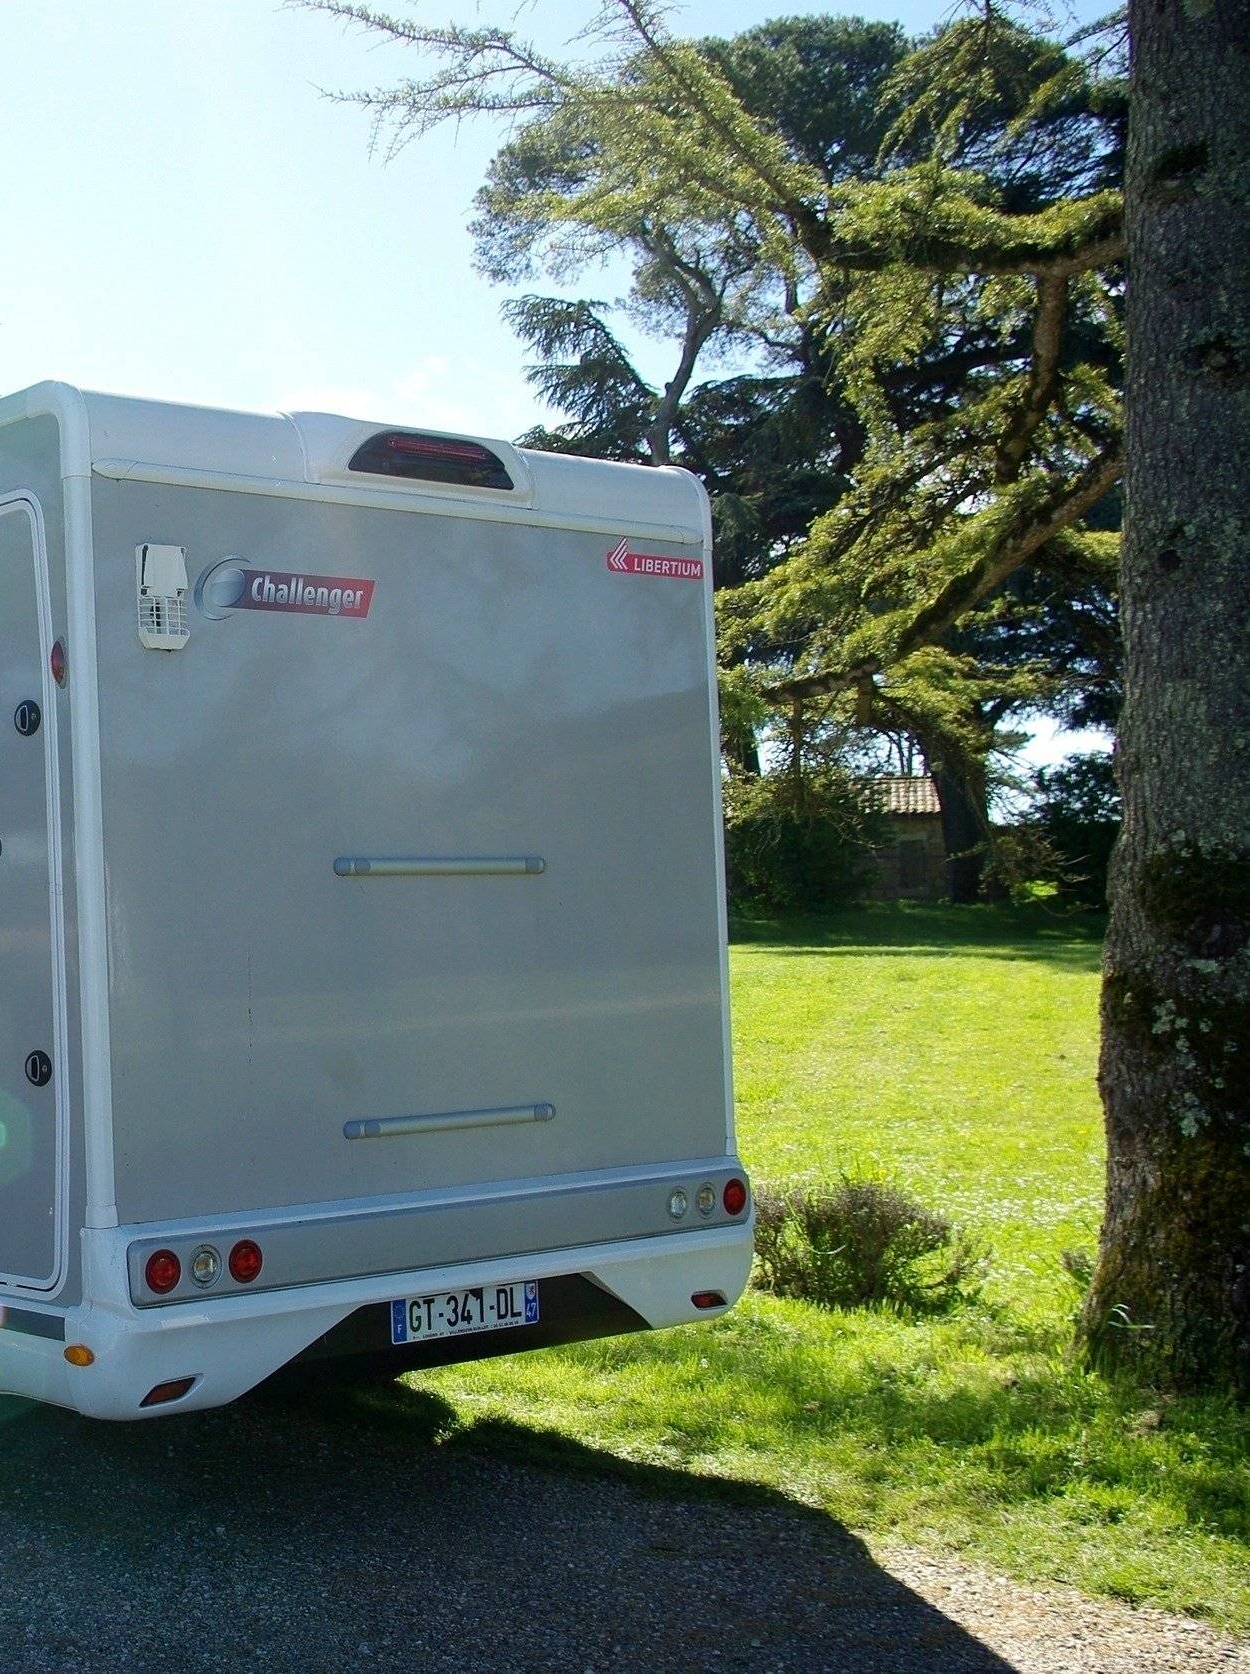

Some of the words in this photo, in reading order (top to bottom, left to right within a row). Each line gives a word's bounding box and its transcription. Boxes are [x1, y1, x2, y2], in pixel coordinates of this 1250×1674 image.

[634, 558, 702, 577] LIBERTIUM
[251, 575, 364, 615] Challenger
[408, 1286, 523, 1333] GT-341-DL
[525, 1302, 537, 1318] 47
